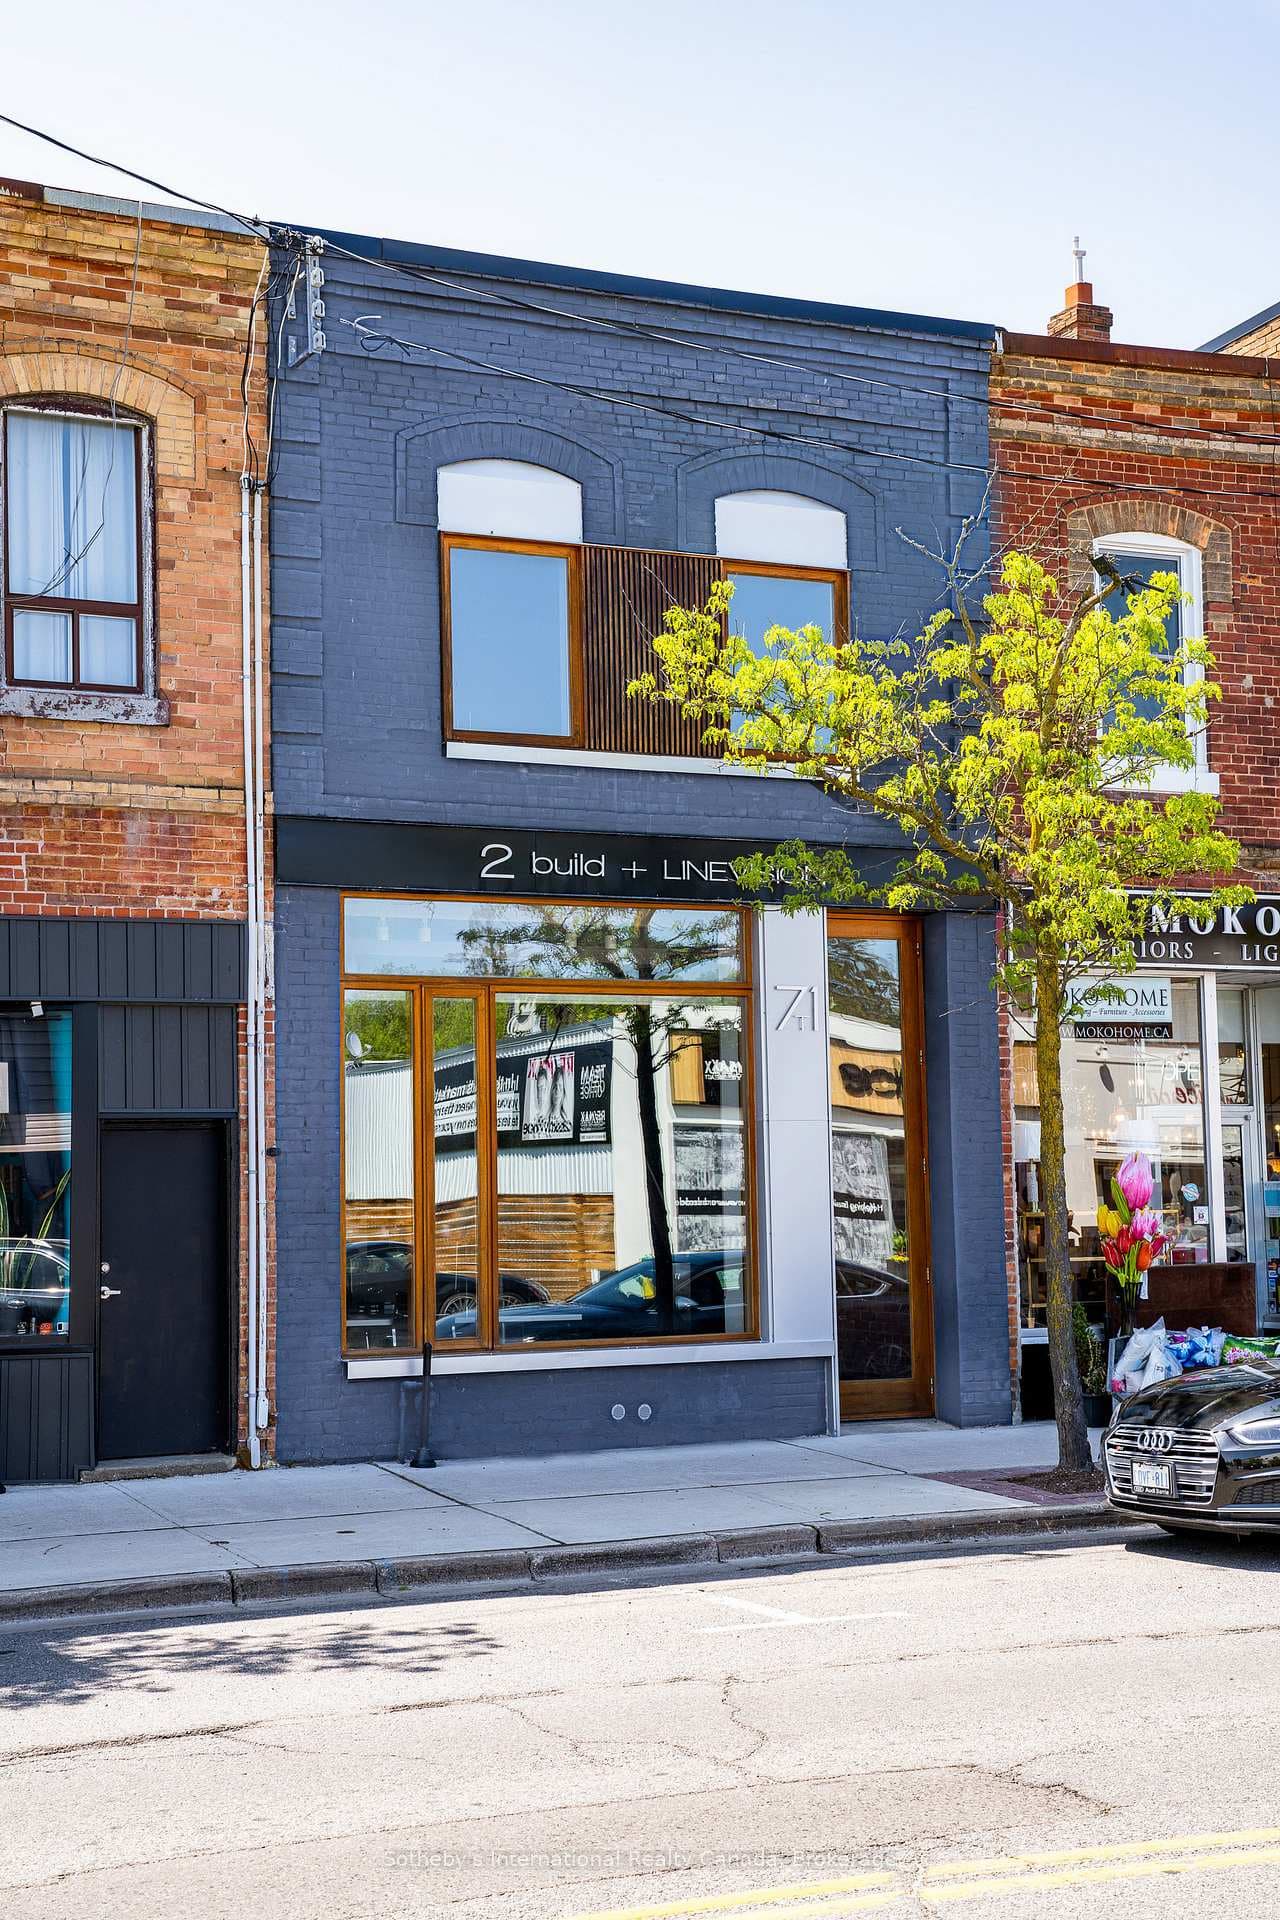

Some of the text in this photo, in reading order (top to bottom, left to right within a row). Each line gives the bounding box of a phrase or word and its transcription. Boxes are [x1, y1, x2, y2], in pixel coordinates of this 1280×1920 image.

[480, 843, 515, 879] 2
[532, 851, 605, 877] build
[663, 859, 826, 886] LINEVSION
